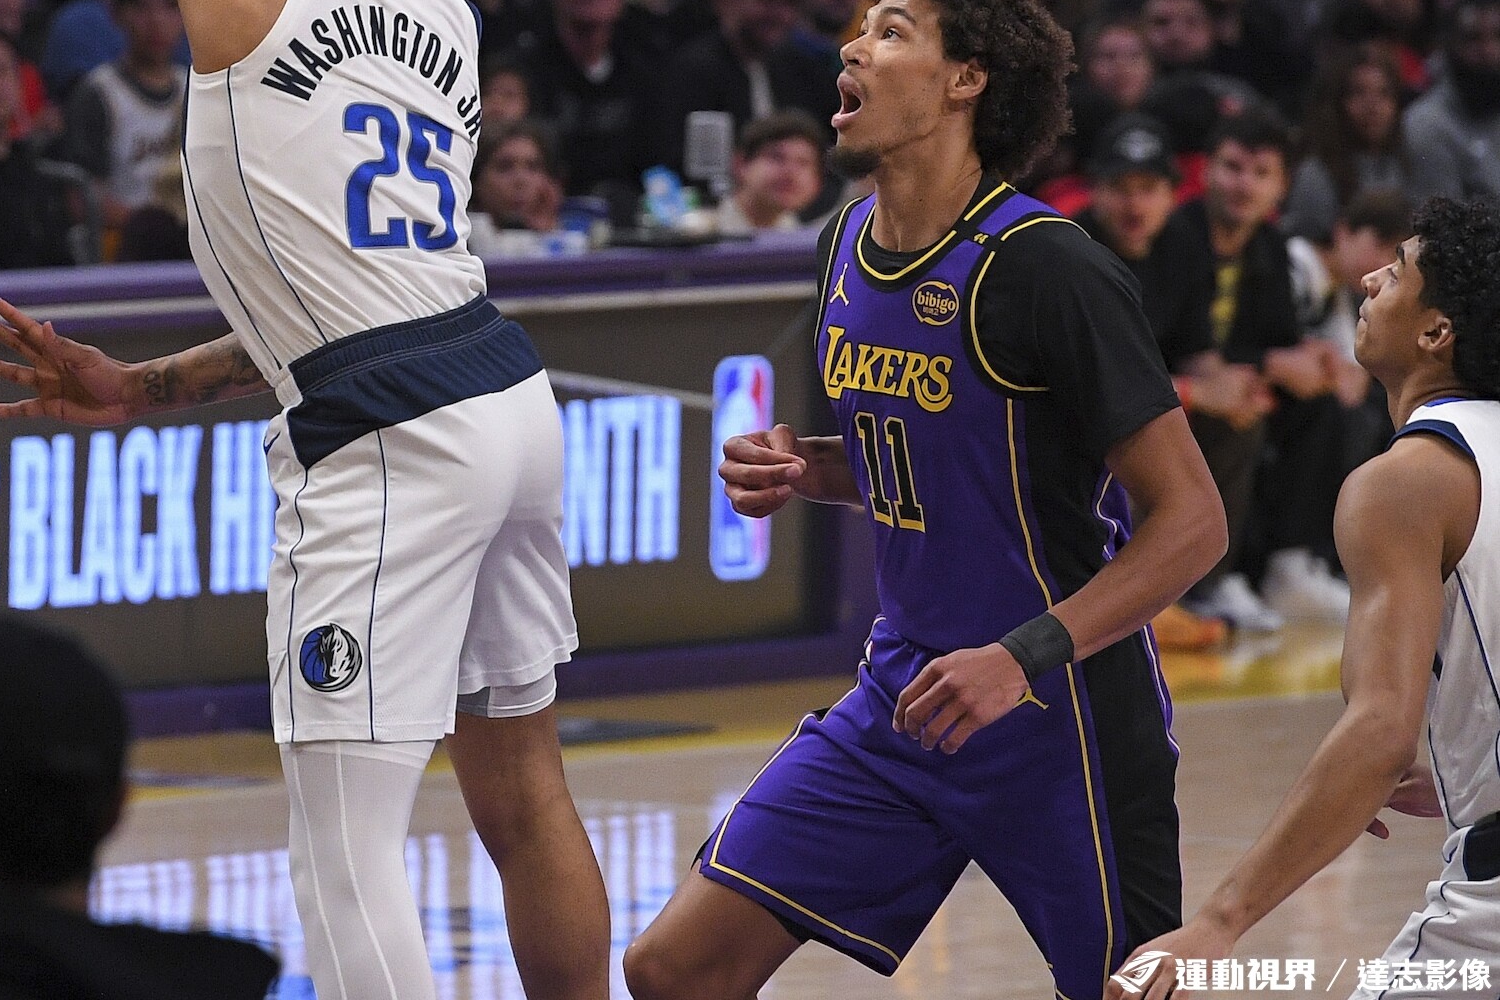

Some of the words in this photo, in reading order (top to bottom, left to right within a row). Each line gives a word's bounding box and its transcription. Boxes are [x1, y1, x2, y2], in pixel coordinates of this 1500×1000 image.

[260, 4, 463, 102] WASHINGTON
[342, 101, 458, 252] 25
[917, 290, 956, 315] bibigo
[824, 325, 954, 413] LAKERS
[8, 424, 203, 611] BLACK
[854, 411, 926, 534] 11
